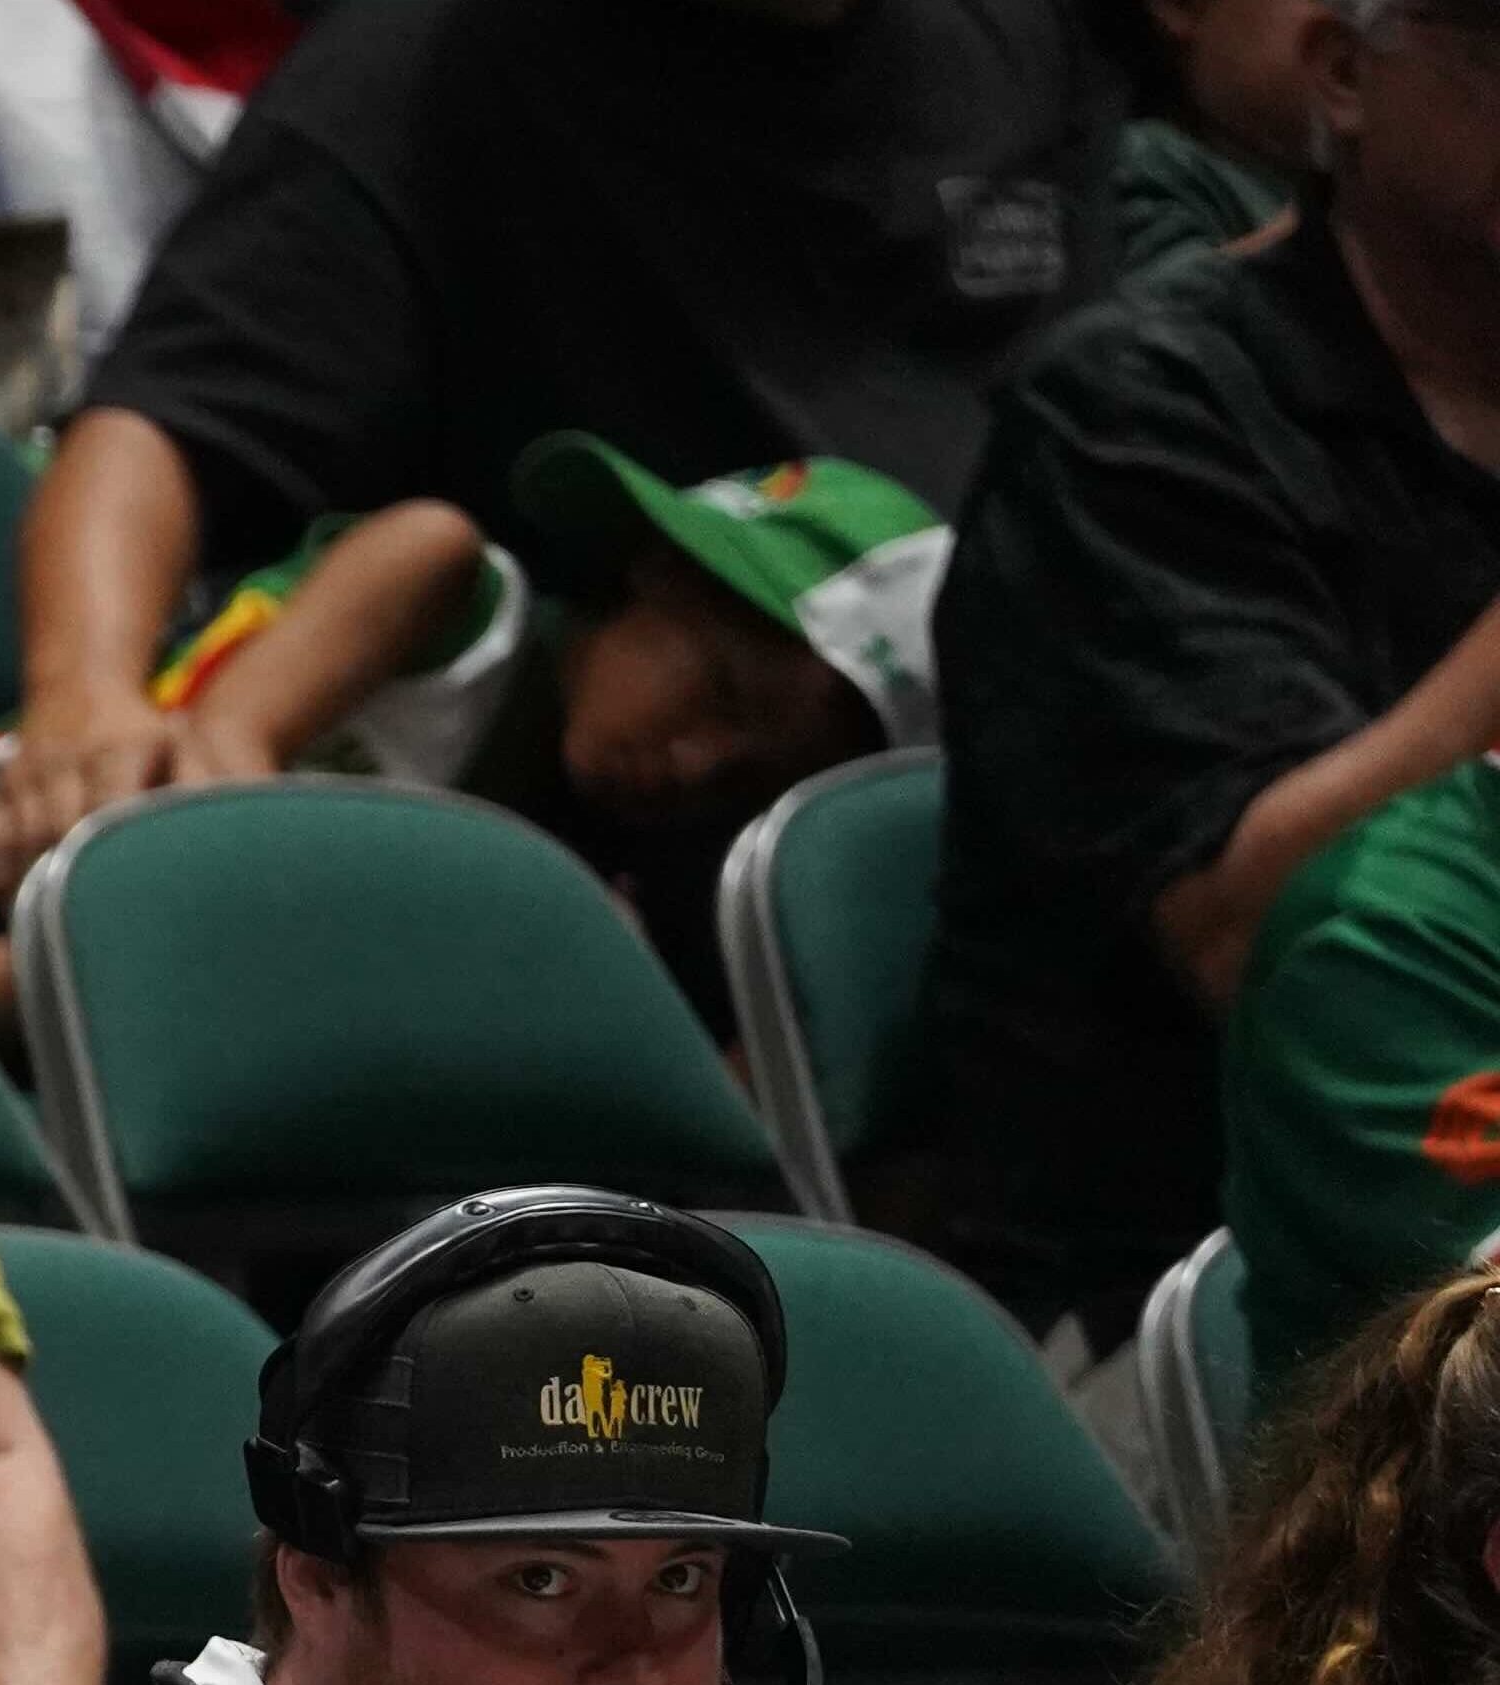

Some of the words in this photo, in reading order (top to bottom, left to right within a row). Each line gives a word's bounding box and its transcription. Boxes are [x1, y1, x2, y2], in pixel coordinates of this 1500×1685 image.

[540, 1376, 587, 1426] da
[631, 1383, 704, 1429] crew
[501, 1441, 589, 1459] Production
